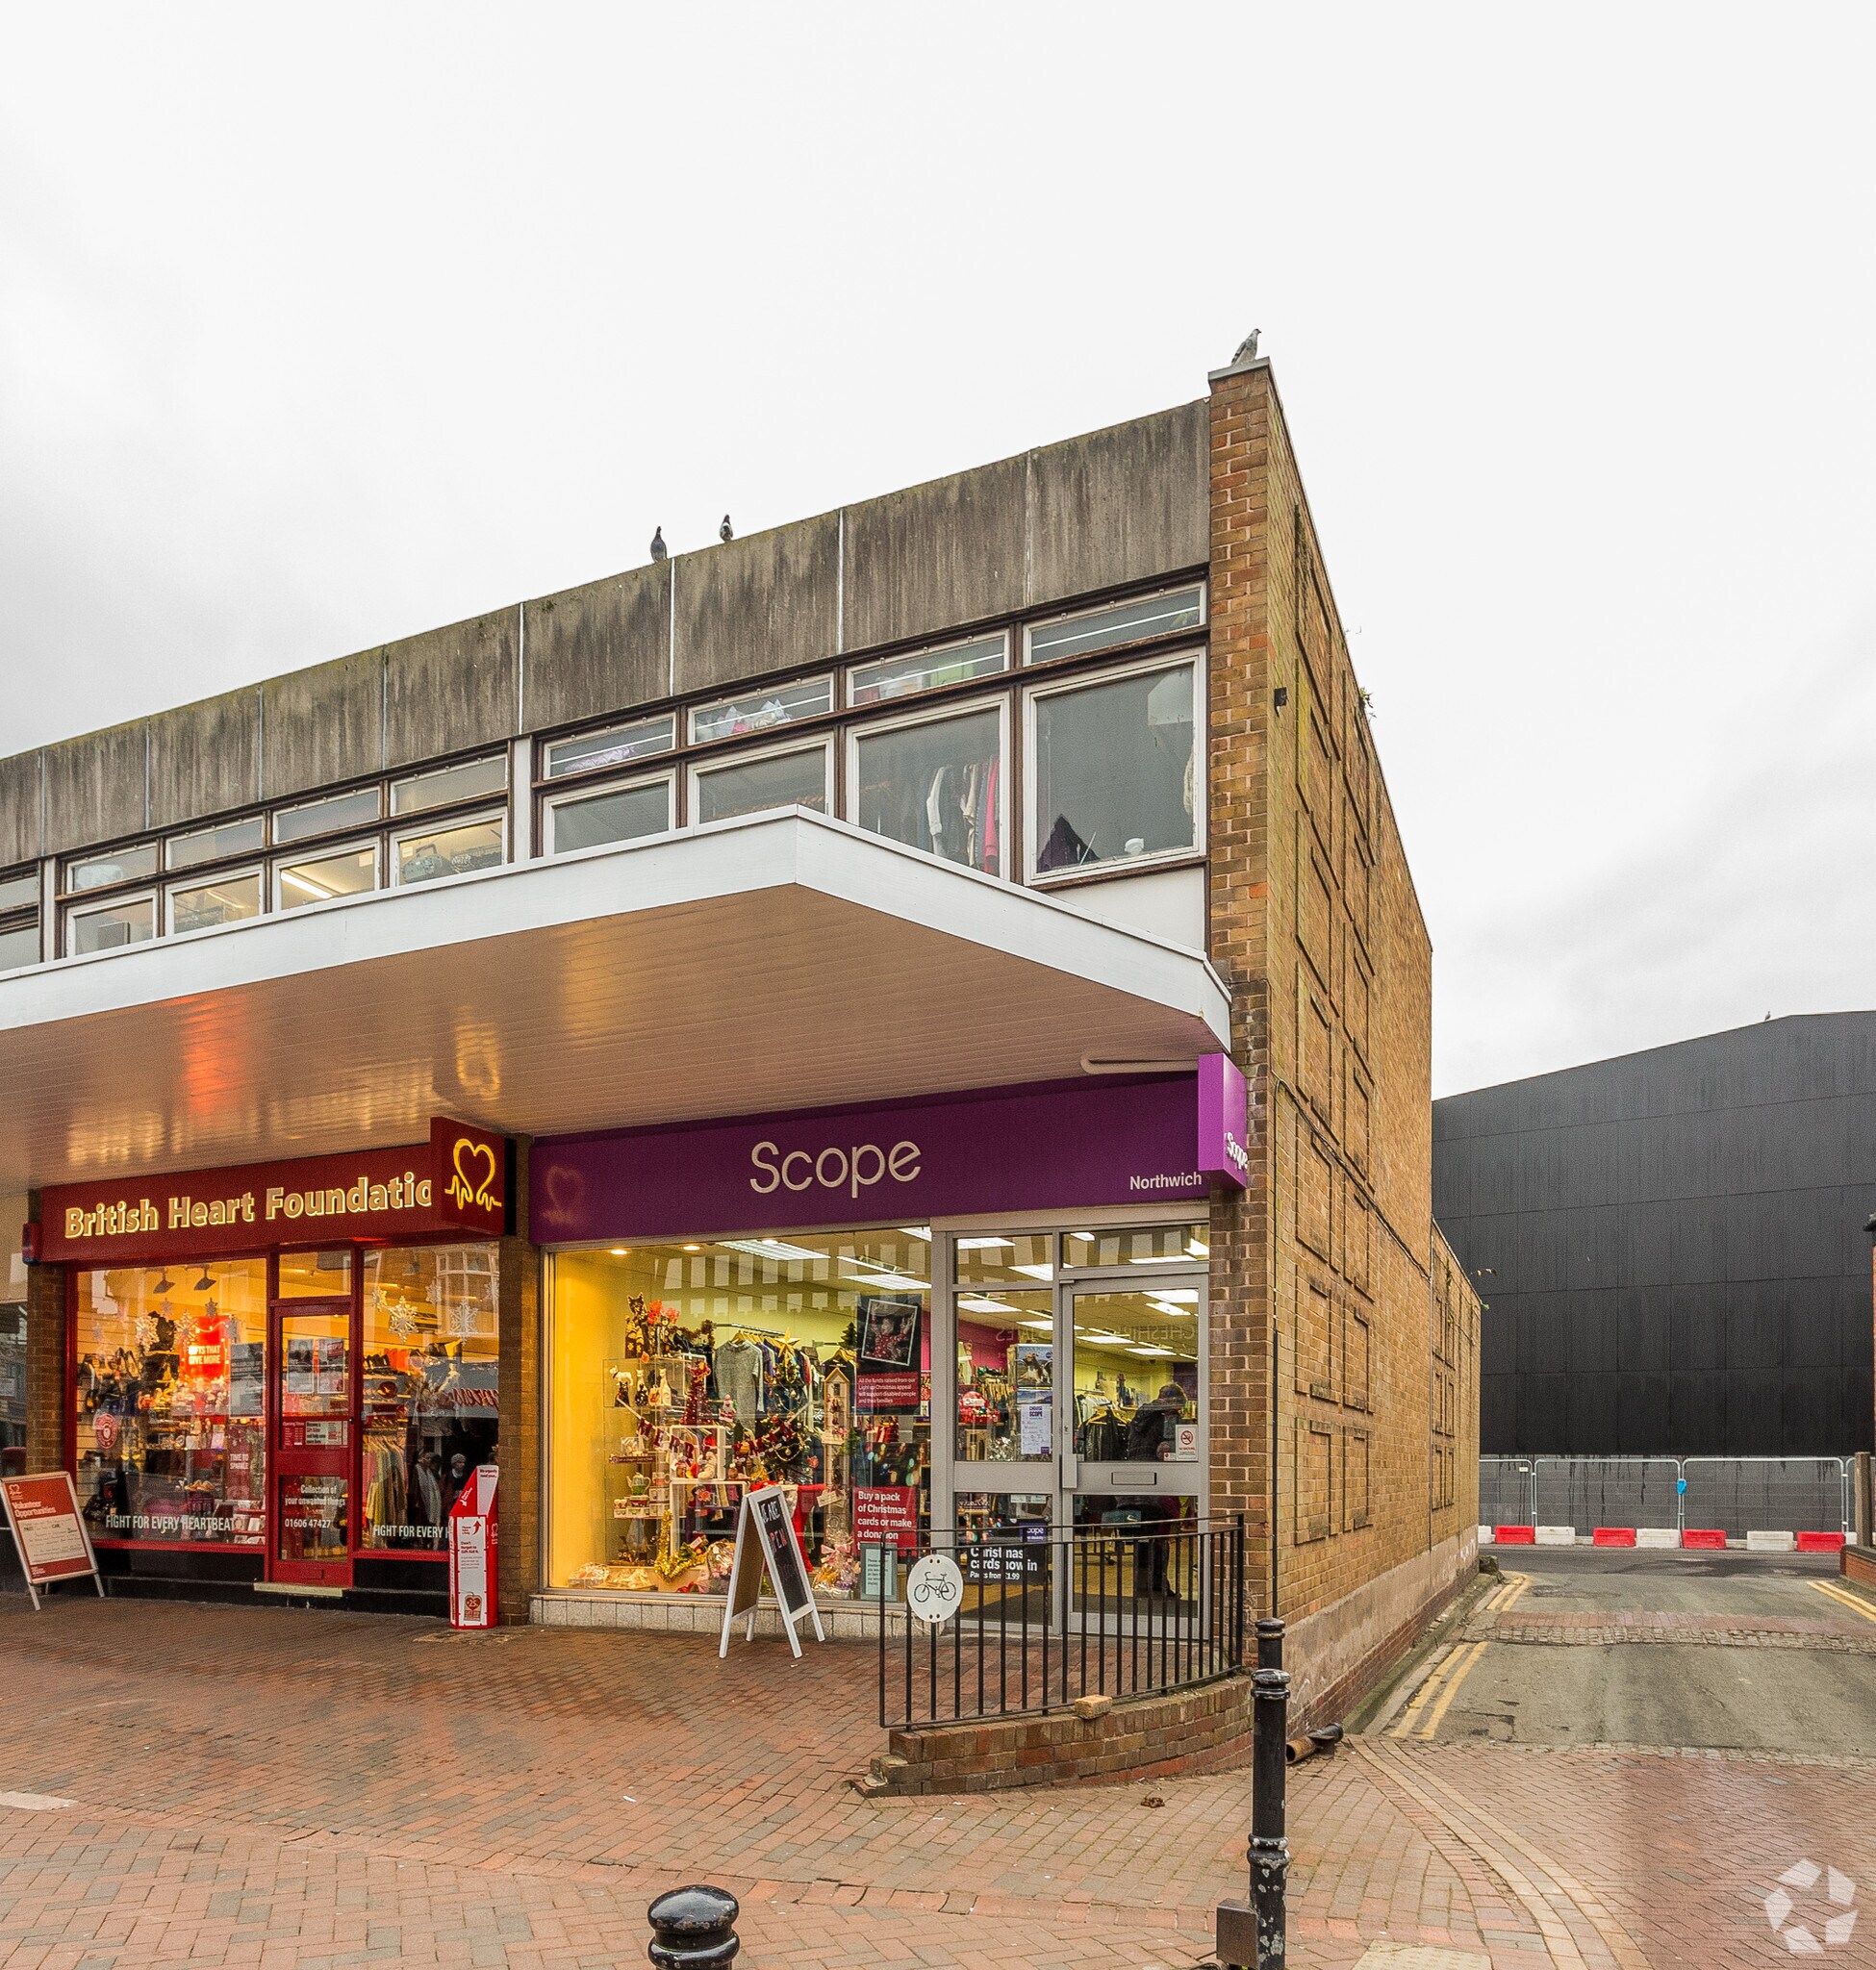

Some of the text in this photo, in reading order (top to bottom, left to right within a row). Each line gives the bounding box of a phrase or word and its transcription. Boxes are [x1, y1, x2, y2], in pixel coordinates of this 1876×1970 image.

[1226, 1131, 1248, 1170] Scope
[749, 1141, 922, 1199] Scope
[1129, 1172, 1203, 1190] Northwich
[64, 1199, 159, 1239] British
[167, 1191, 255, 1229] Heart
[300, 1484, 329, 1494] Collection
[285, 1497, 297, 1506] your
[858, 1491, 874, 1502] Buy
[880, 1493, 900, 1503] pack
[857, 1503, 907, 1514] of Christmas
[106, 1515, 236, 1531] FIGHT FOR EVERY HEARTBEAT
[285, 1518, 331, 1528] 01606 47427
[857, 1517, 879, 1526] cards
[890, 1519, 912, 1528] make
[373, 1525, 397, 1537] FIGHT
[398, 1525, 415, 1537] FOR
[417, 1526, 444, 1538] EVERY
[769, 1528, 788, 1553] PEN
[1027, 1559, 1038, 1571] in
